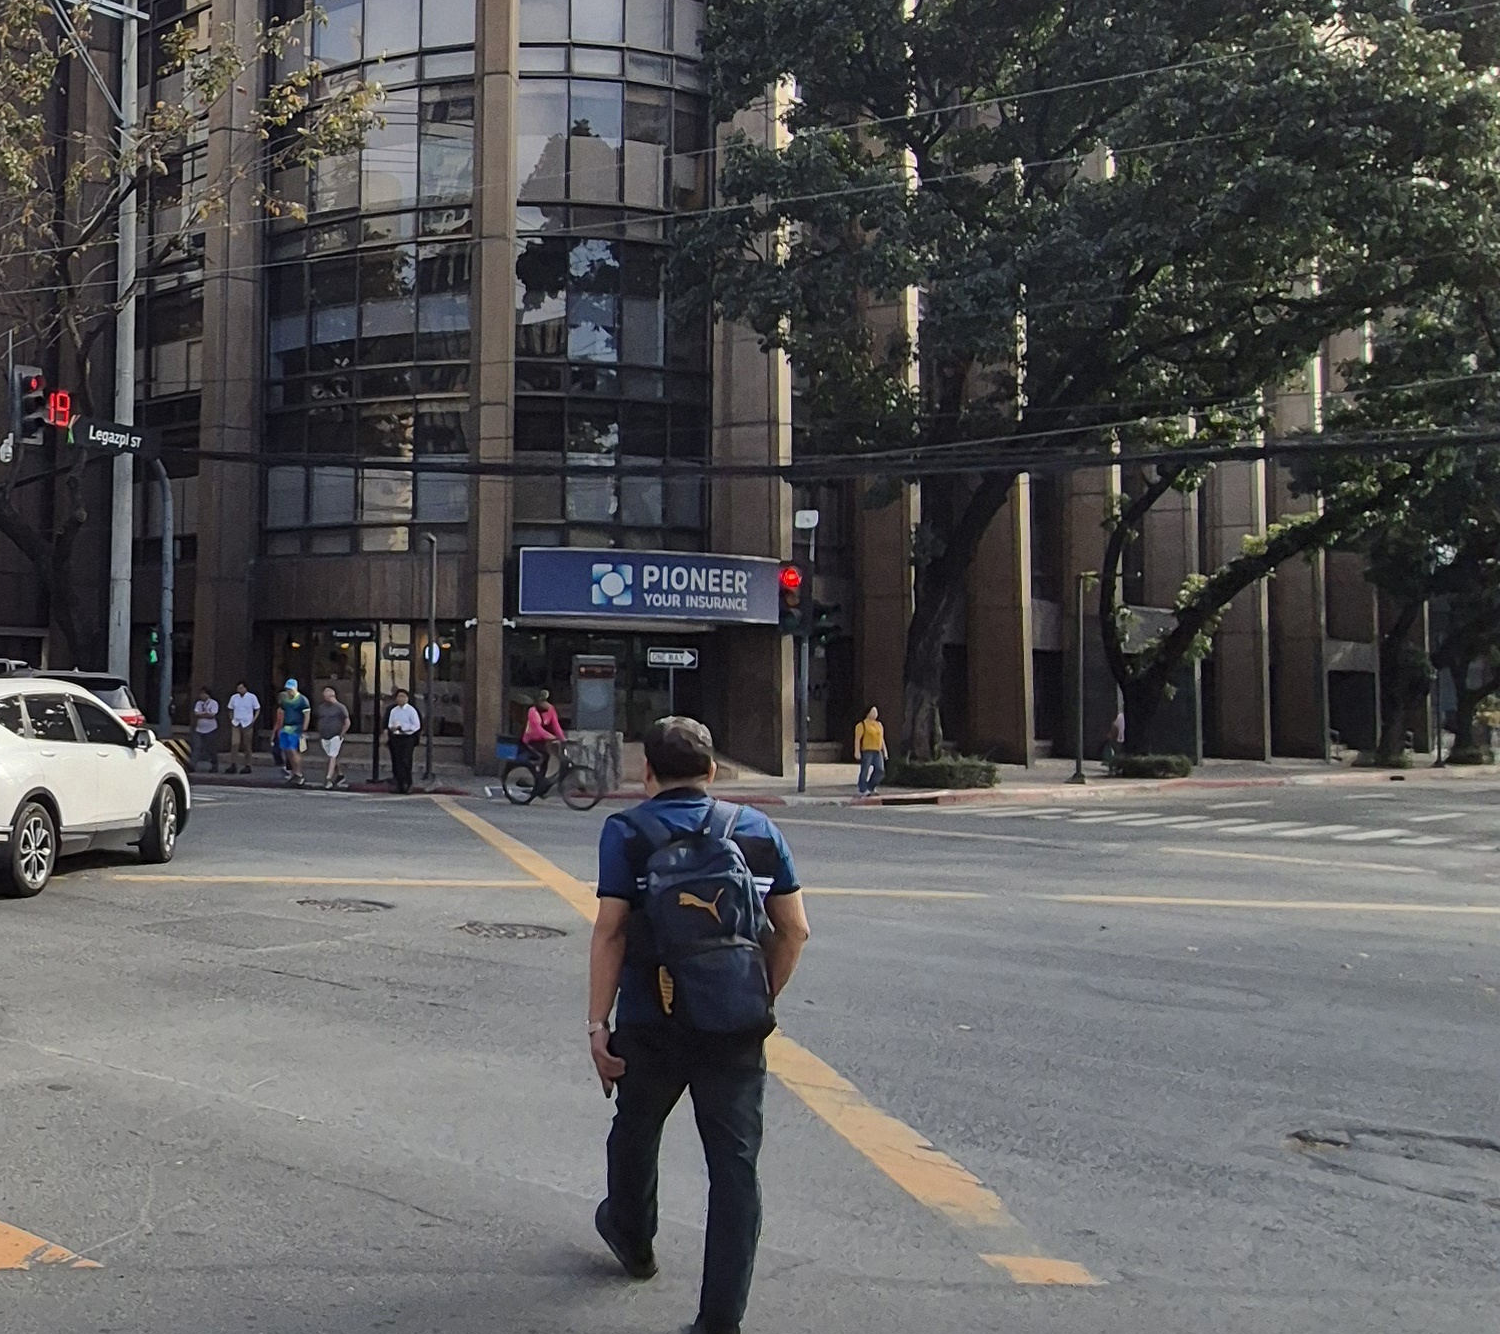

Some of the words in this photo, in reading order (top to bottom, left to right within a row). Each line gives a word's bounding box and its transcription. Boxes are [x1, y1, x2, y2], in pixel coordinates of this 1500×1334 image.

[49, 391, 71, 427] 19
[88, 424, 129, 448] Legazpi
[643, 565, 748, 595] PIONEER
[643, 593, 681, 607] YOUR
[685, 595, 748, 611] INSURANCE
